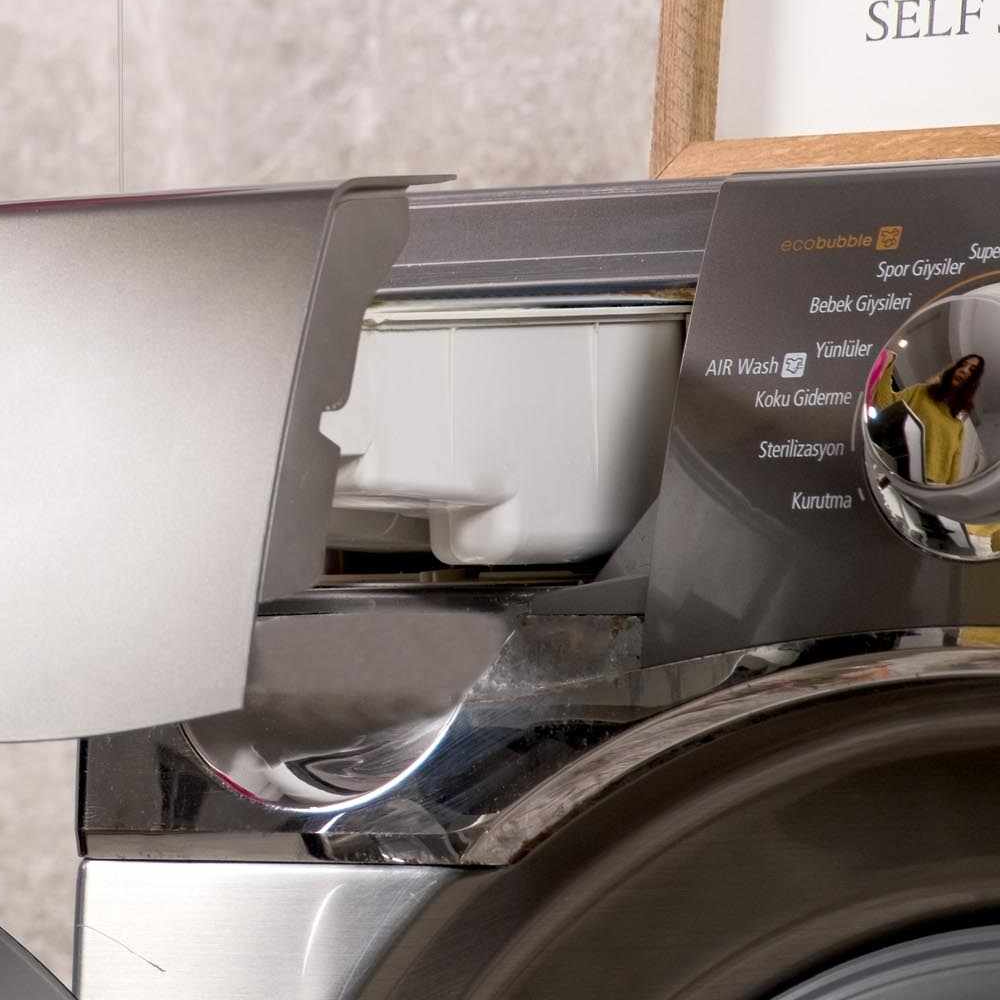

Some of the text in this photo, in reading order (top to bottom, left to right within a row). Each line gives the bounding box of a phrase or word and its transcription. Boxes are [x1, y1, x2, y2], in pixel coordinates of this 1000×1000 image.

[780, 233, 873, 252] ecobubble
[876, 257, 966, 282] Spor Giysiler
[809, 292, 913, 317] Bebek Giysileri
[816, 340, 873, 359] Yünlüler
[705, 356, 779, 377] AIR Wash
[755, 389, 852, 408] Koku Giderme
[758, 439, 845, 461] Sterilizasyon
[791, 492, 852, 510] Kurutma
